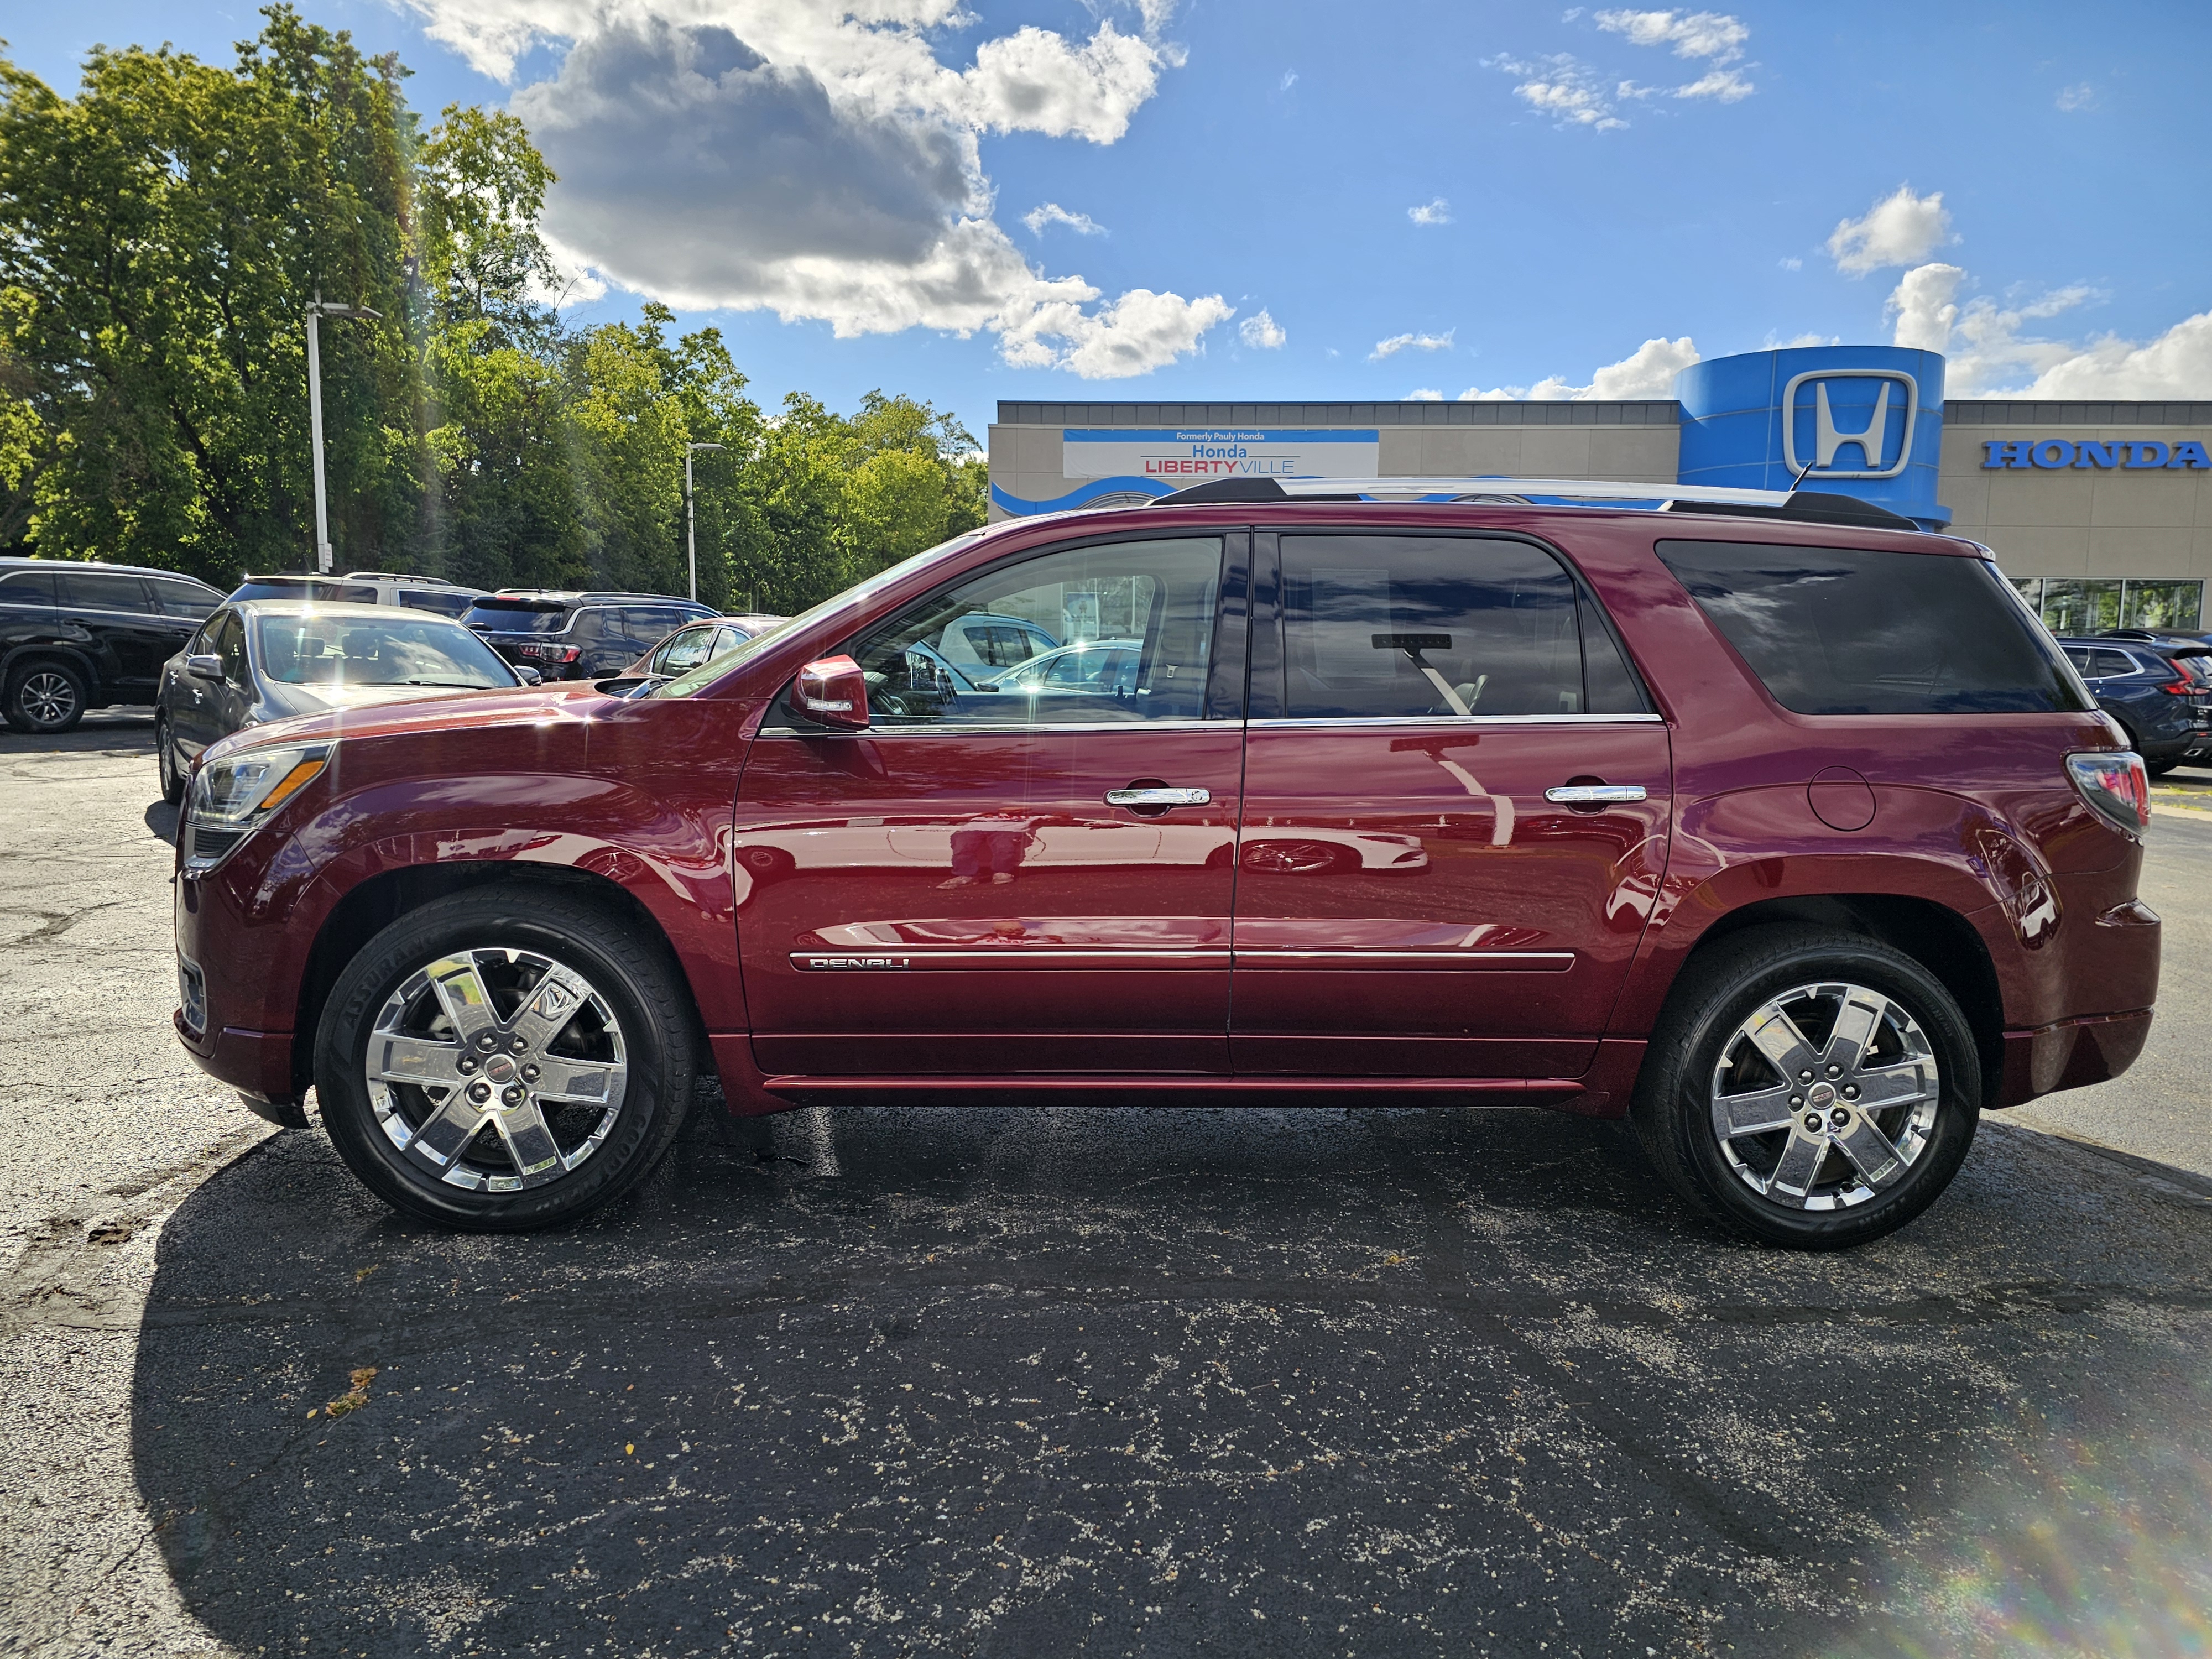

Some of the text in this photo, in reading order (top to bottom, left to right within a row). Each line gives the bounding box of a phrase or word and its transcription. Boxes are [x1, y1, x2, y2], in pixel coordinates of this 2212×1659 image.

[1176, 432, 1265, 442] Formerly Pauly Honda
[1192, 444, 1248, 458] Honda
[1983, 439, 2212, 469] HONDA
[809, 958, 910, 969] DENALI
[343, 931, 447, 1030] ASSURANC
